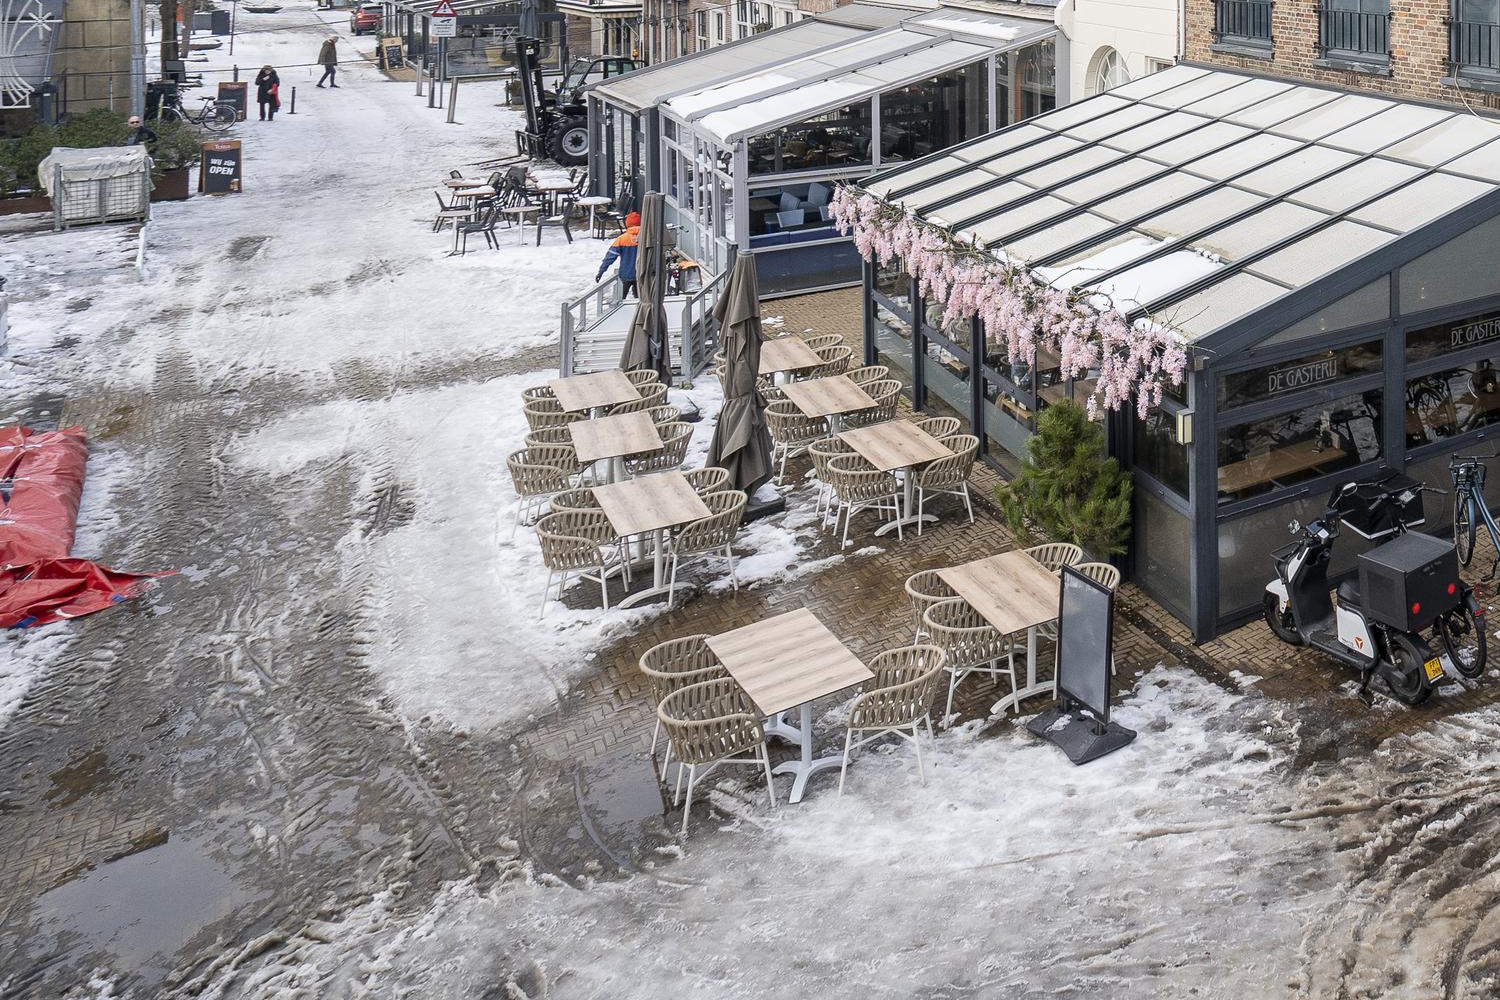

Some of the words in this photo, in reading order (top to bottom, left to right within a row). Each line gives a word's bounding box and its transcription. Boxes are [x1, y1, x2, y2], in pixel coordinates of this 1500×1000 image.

[209, 166, 234, 175] OPEN
[1451, 329, 1463, 346] DE
[1269, 373, 1283, 392] DE
[1286, 360, 1337, 386] GASTERIJ
